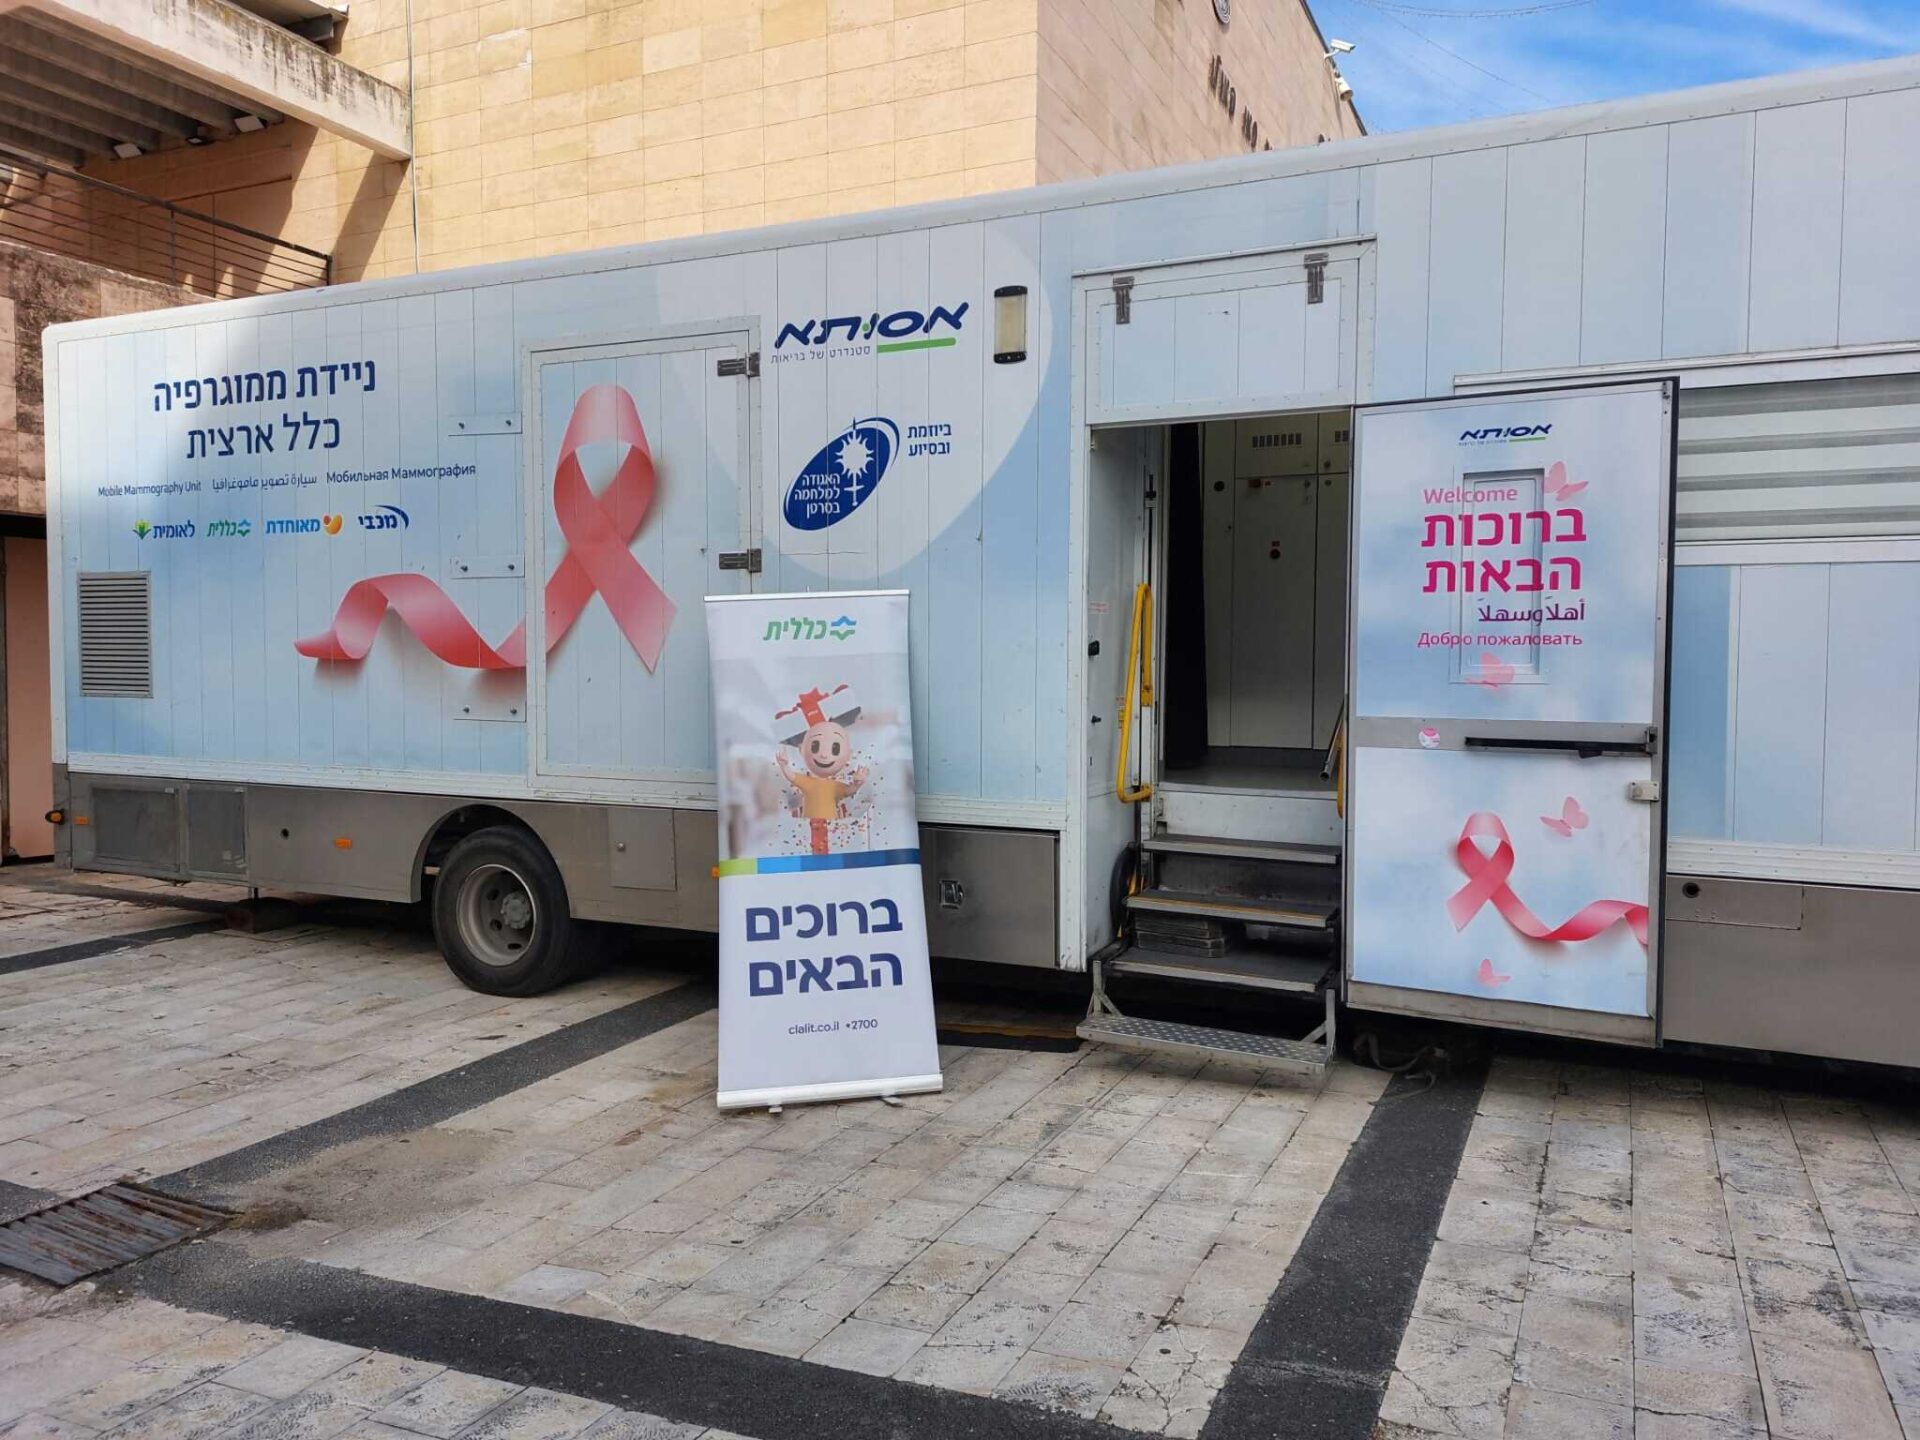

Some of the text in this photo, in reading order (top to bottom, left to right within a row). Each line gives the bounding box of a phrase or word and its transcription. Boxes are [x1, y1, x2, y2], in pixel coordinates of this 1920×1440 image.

[774, 302, 969, 349] אסותא
[770, 345, 871, 364] סטנדרט של בריאות
[154, 360, 377, 411] ניידת ממוגרפיה
[187, 411, 341, 459] כלל ארצית
[907, 422, 952, 438] ביוזמת
[1460, 424, 1552, 440] אסותא
[908, 441, 951, 456] ובסיוע
[260, 473, 289, 490] تصوير
[290, 472, 317, 488] سيارة
[326, 464, 476, 484] Мобильная Маммография
[802, 473, 840, 486] האגודה
[98, 480, 202, 496] Mobile Mammography Unit
[794, 486, 840, 500] למלחמה
[1424, 486, 1518, 504] Welcome
[807, 502, 840, 519] בסרטן
[153, 520, 195, 539] לאומית
[207, 519, 237, 537] כללית
[265, 518, 320, 534] מאוחדת
[358, 514, 398, 530] מכבי
[1421, 508, 1587, 547] ברוכות
[1423, 557, 1581, 593] הבאות
[763, 617, 827, 641] כללית
[1417, 632, 1583, 648] Добро пожаловать
[745, 898, 903, 942] ברוכים
[749, 953, 903, 997] הבאים
[788, 1021, 840, 1035] clalit.co.il
